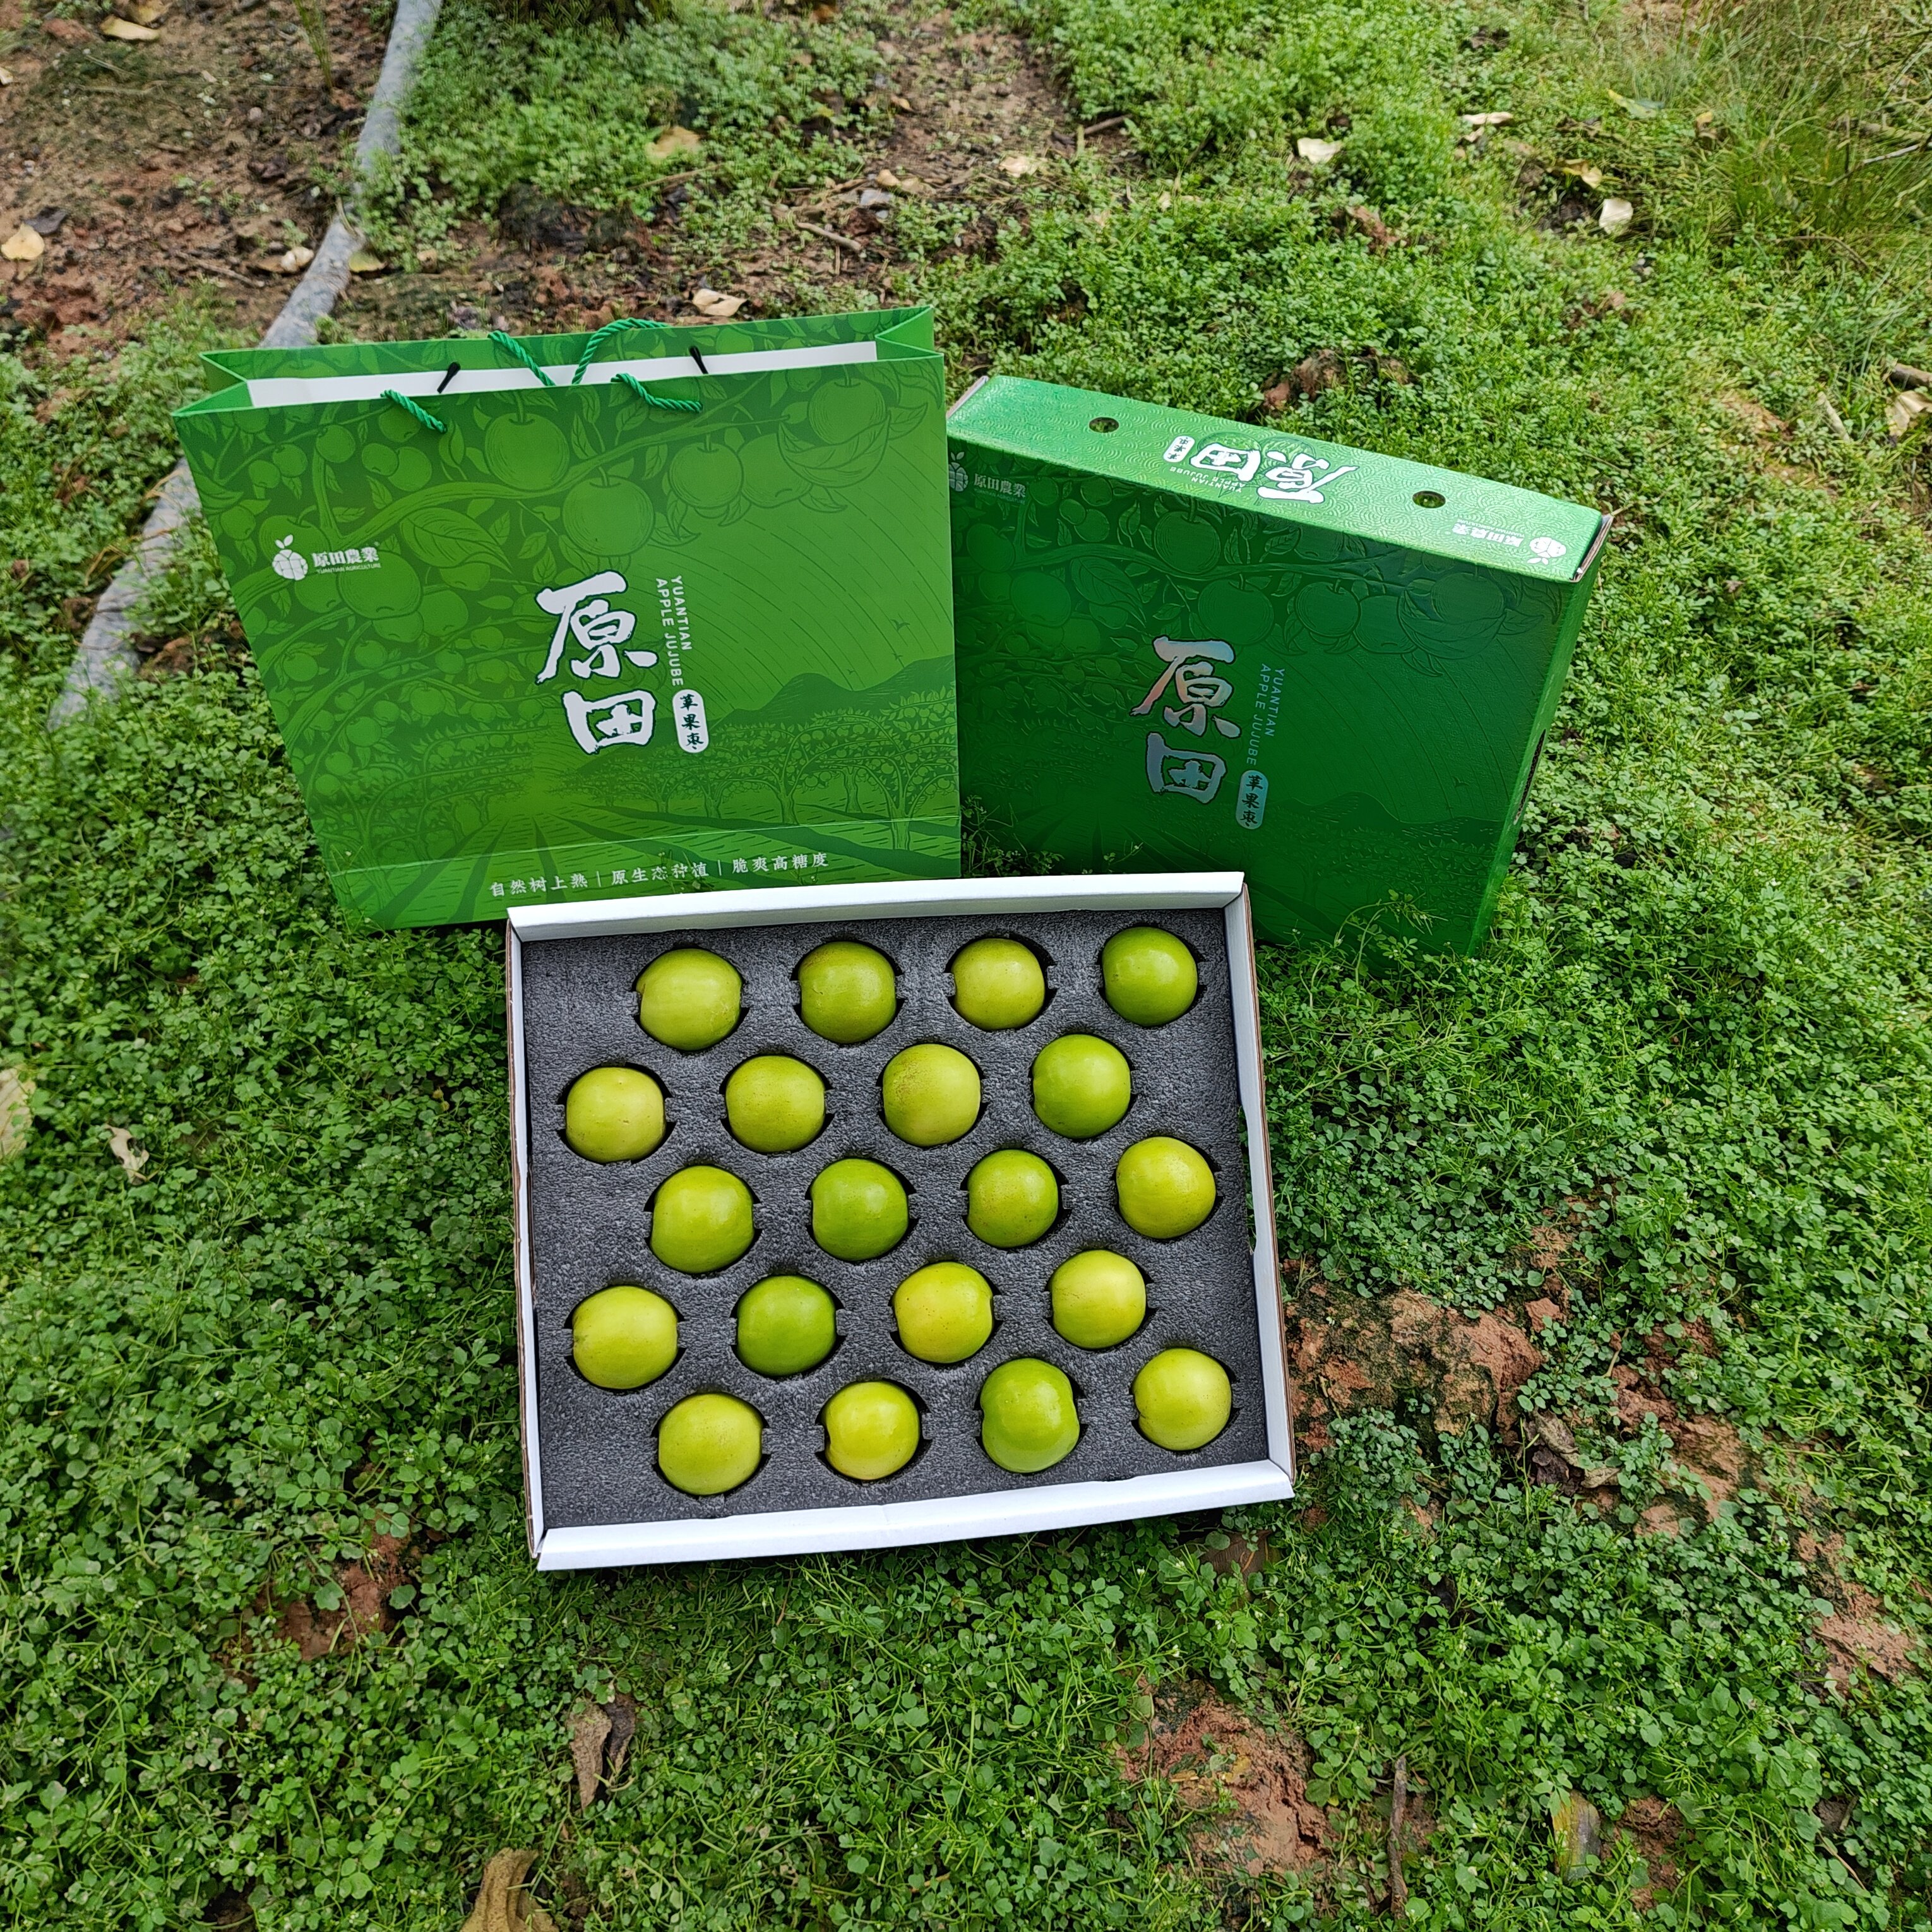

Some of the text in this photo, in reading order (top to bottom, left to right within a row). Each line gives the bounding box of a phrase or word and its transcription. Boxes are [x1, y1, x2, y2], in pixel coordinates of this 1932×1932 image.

[1169, 466, 1246, 488] APPLE JUJUBE
[1191, 475, 1243, 493] YUANTIAN
[656, 578, 684, 686] APPLE JUJUBE
[671, 575, 693, 651] YUANTIAN
[535, 570, 659, 755] 原田
[679, 693, 704, 750] 苹果枣
[1130, 635, 1241, 804] 原田
[1246, 663, 1272, 766] APPLE JUJUBE
[1264, 668, 1285, 737] YUANTIAN
[1240, 775, 1263, 826] 苹果枣
[489, 874, 588, 897] 自然树上熟
[731, 852, 829, 874] 脆爽高糖度
